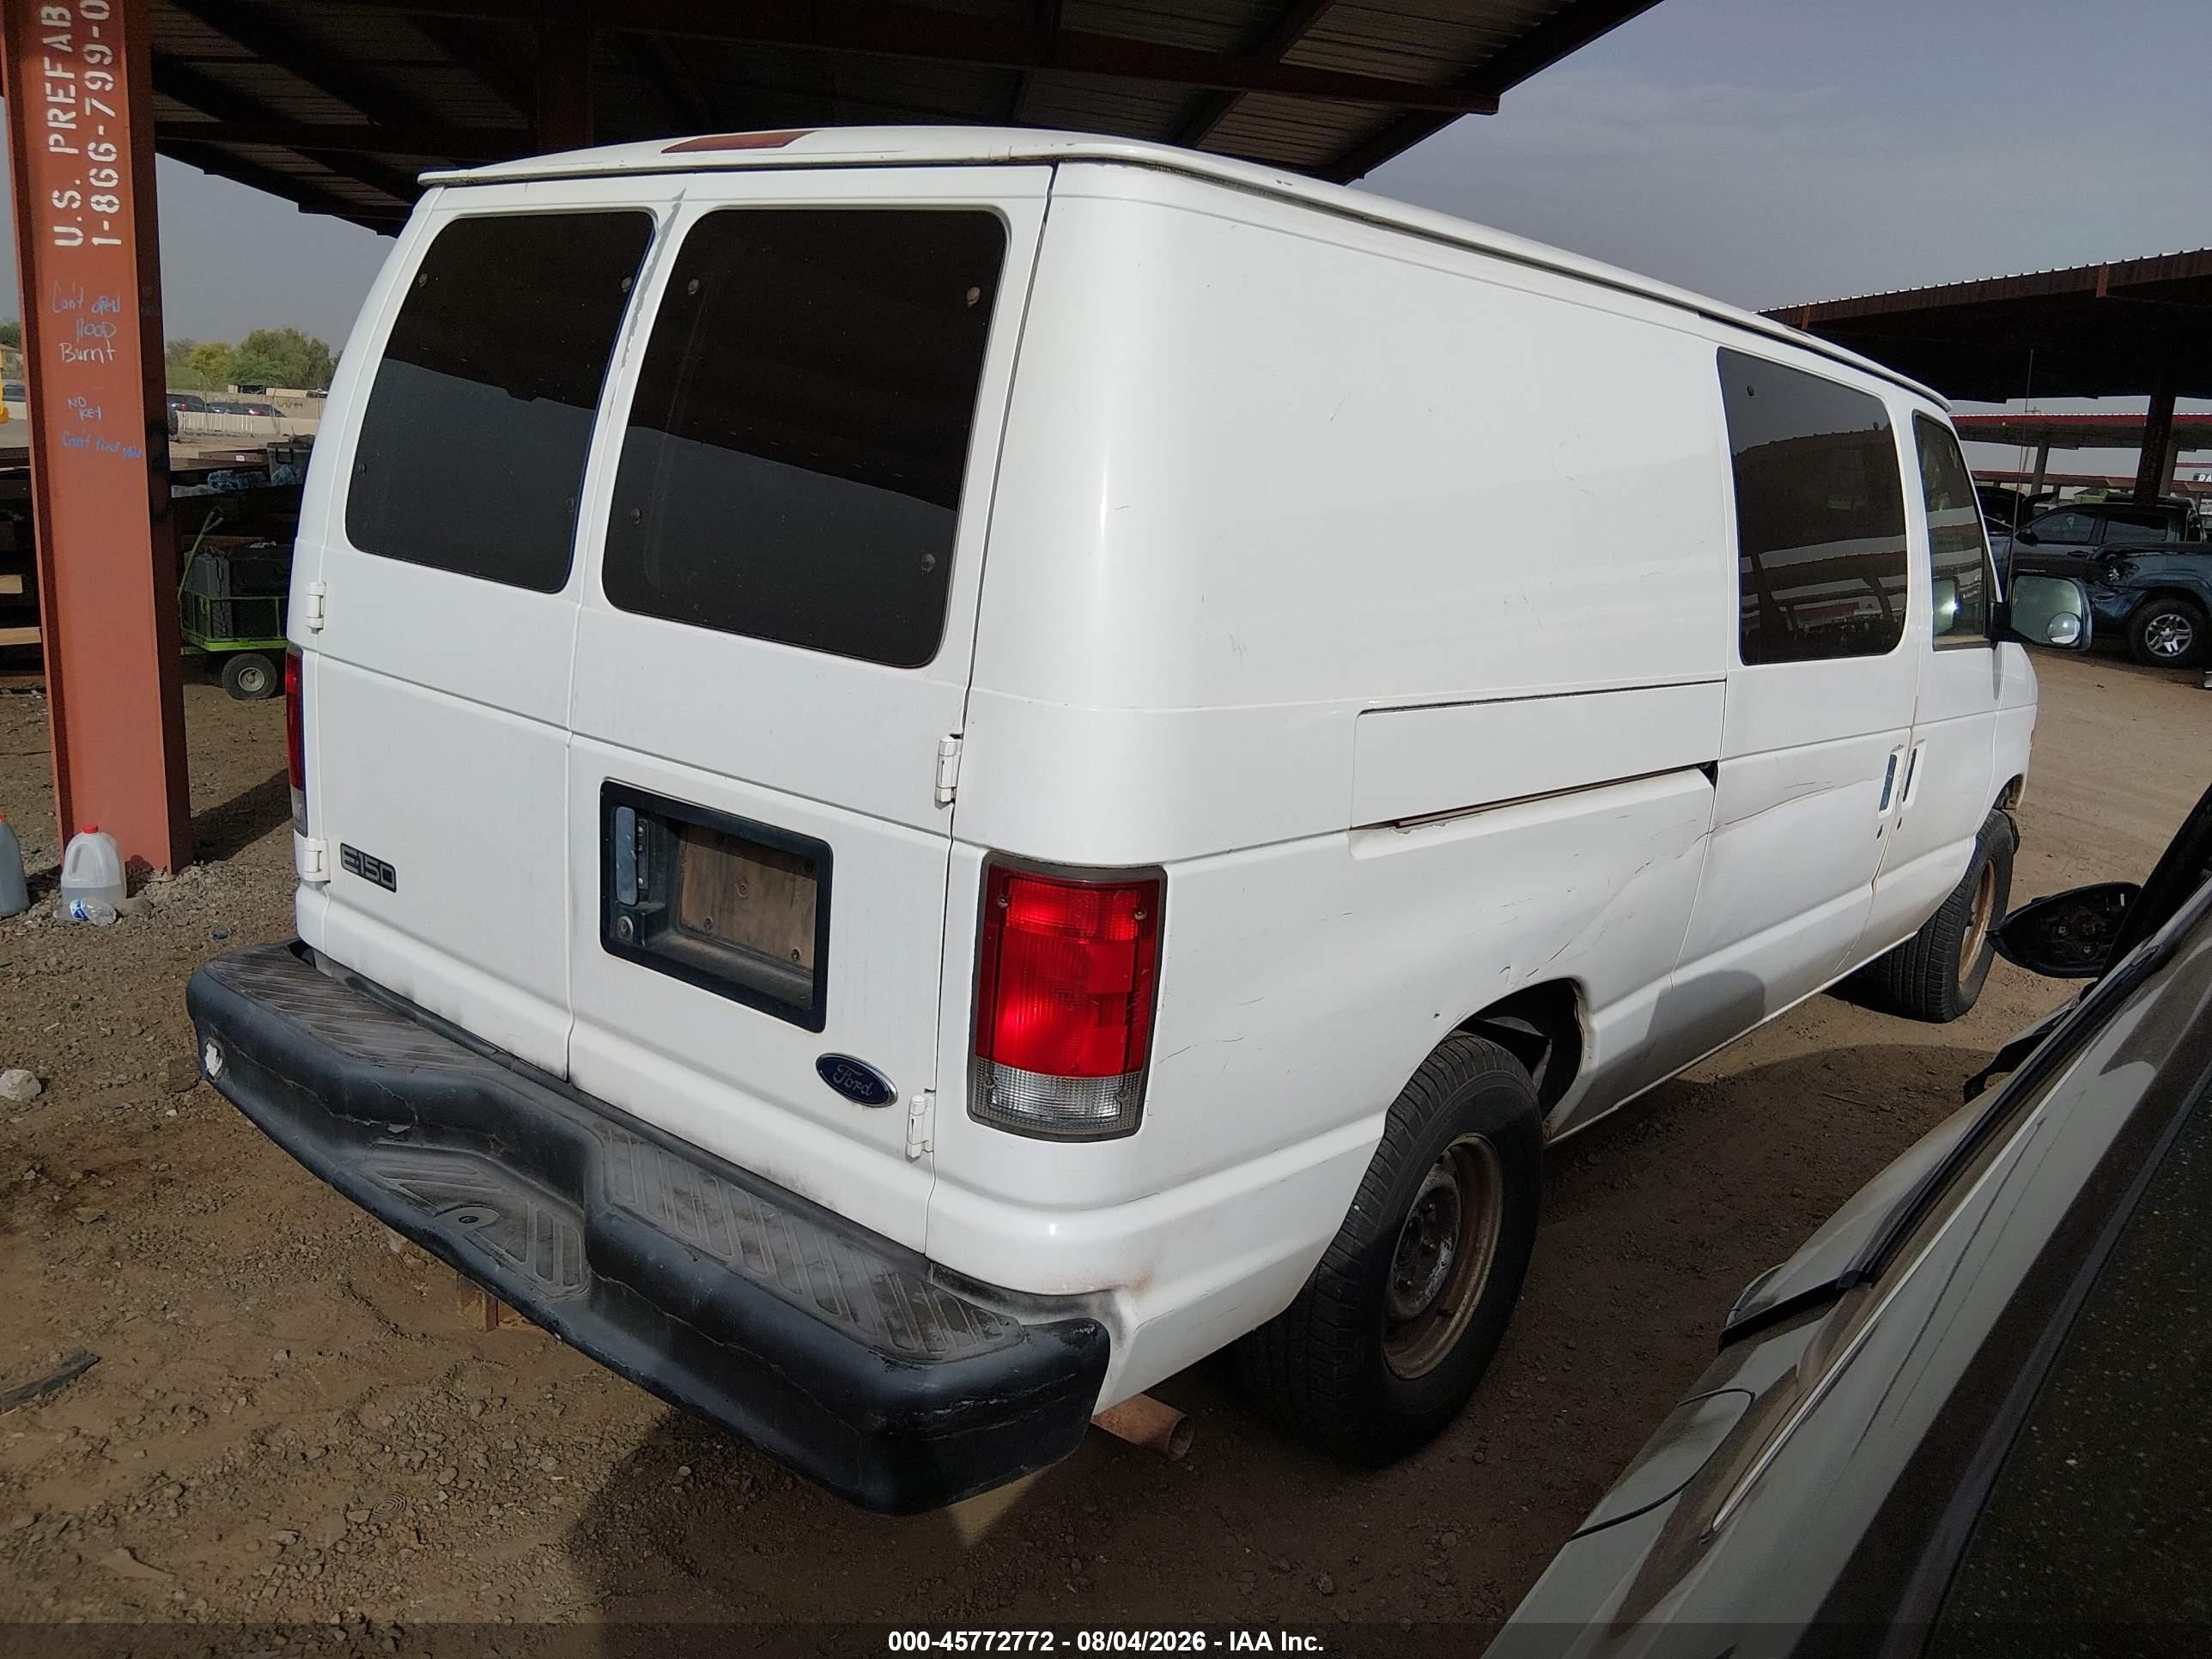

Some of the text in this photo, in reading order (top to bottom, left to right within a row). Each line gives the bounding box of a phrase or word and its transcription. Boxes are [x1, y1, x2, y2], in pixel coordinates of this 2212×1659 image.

[40, 6, 83, 246] U.S. PREFAB
[59, 338, 117, 364] Burnt
